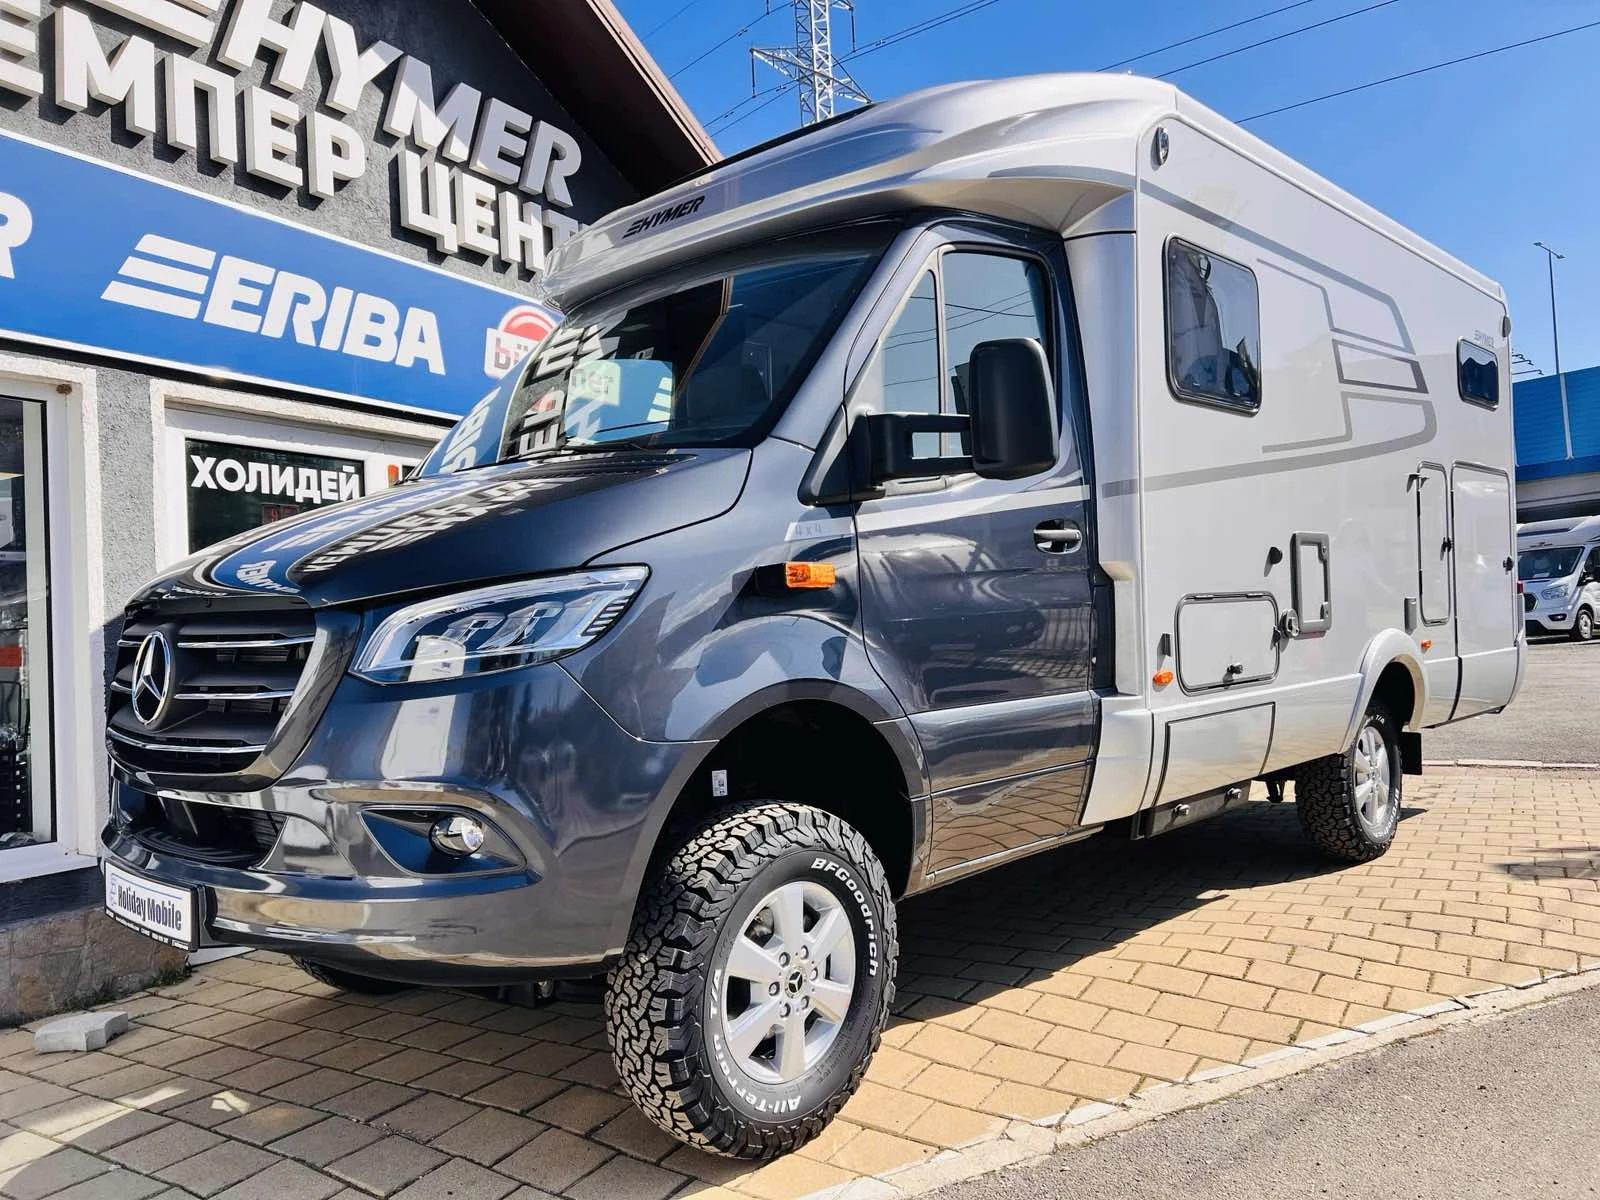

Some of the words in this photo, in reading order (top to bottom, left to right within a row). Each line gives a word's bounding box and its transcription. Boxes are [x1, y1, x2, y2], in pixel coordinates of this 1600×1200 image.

[215, 0, 582, 207] HYMER
[400, 148, 590, 272] ЦЕНТ
[634, 195, 706, 234] HYMER
[202, 254, 445, 375] ERIBA
[190, 454, 360, 504] ХОЛИДЕЙ
[117, 884, 146, 922] Holiday
[147, 897, 182, 931] Mobile
[811, 857, 877, 977] BFGoodrich
